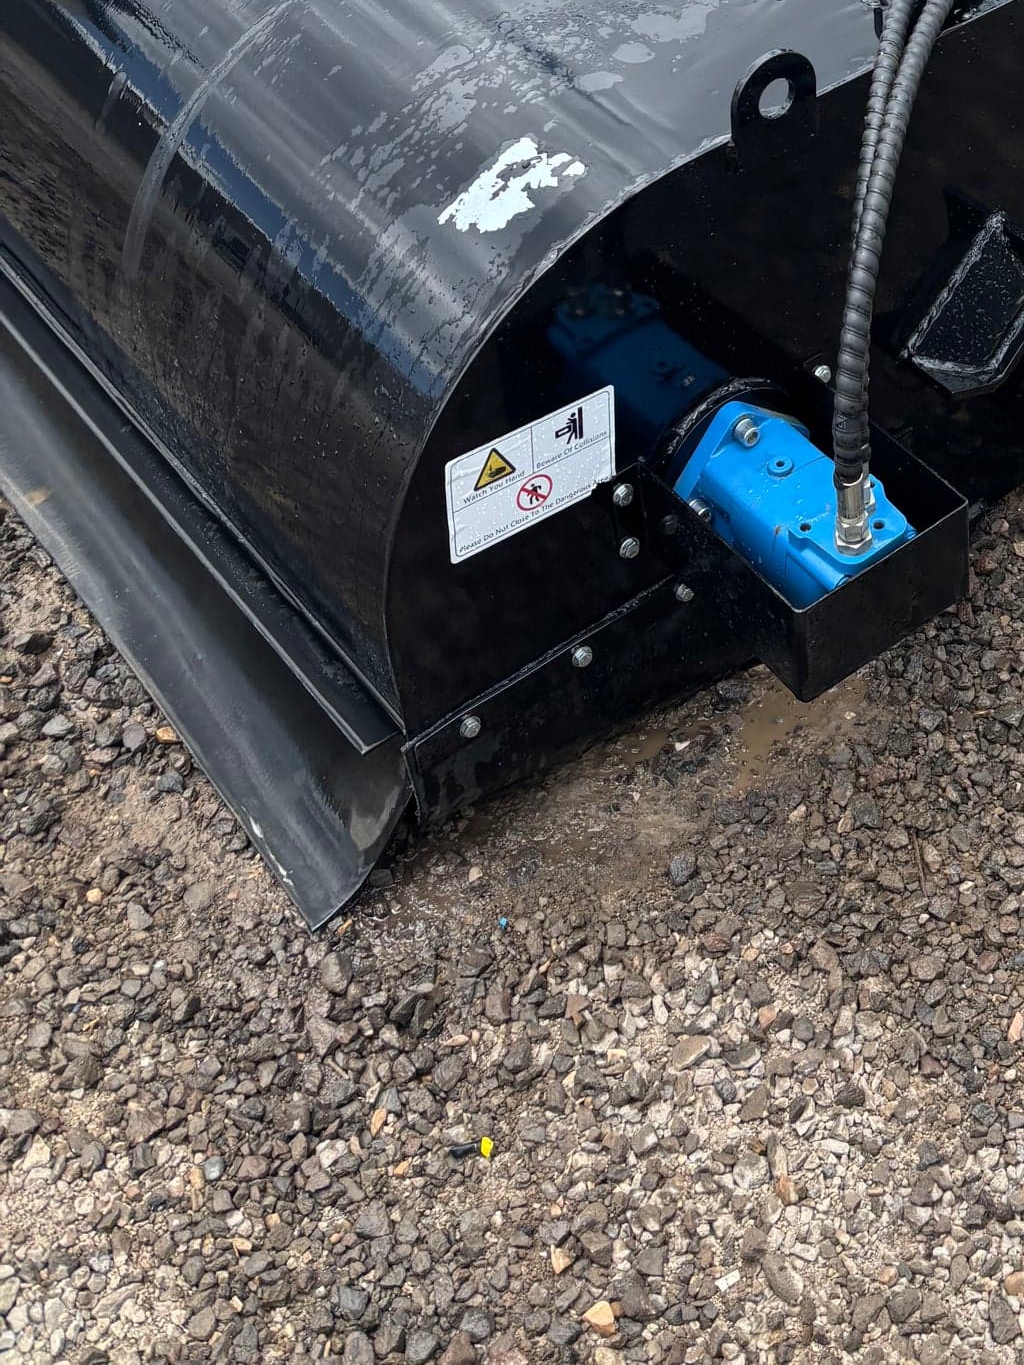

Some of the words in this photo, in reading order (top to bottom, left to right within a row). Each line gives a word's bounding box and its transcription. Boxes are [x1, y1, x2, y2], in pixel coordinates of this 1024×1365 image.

[536, 453, 562, 469] Beware
[563, 447, 573, 456] Of
[574, 430, 607, 451] Collisions
[463, 489, 488, 505] Watch
[488, 481, 504, 495] You
[505, 470, 525, 485] Hand
[459, 538, 482, 553] Please
[483, 532, 494, 542] Do
[495, 524, 509, 536] Not
[510, 514, 530, 528] Close
[531, 508, 540, 518] To
[541, 501, 554, 513] The
[555, 483, 592, 507] Dangerous
